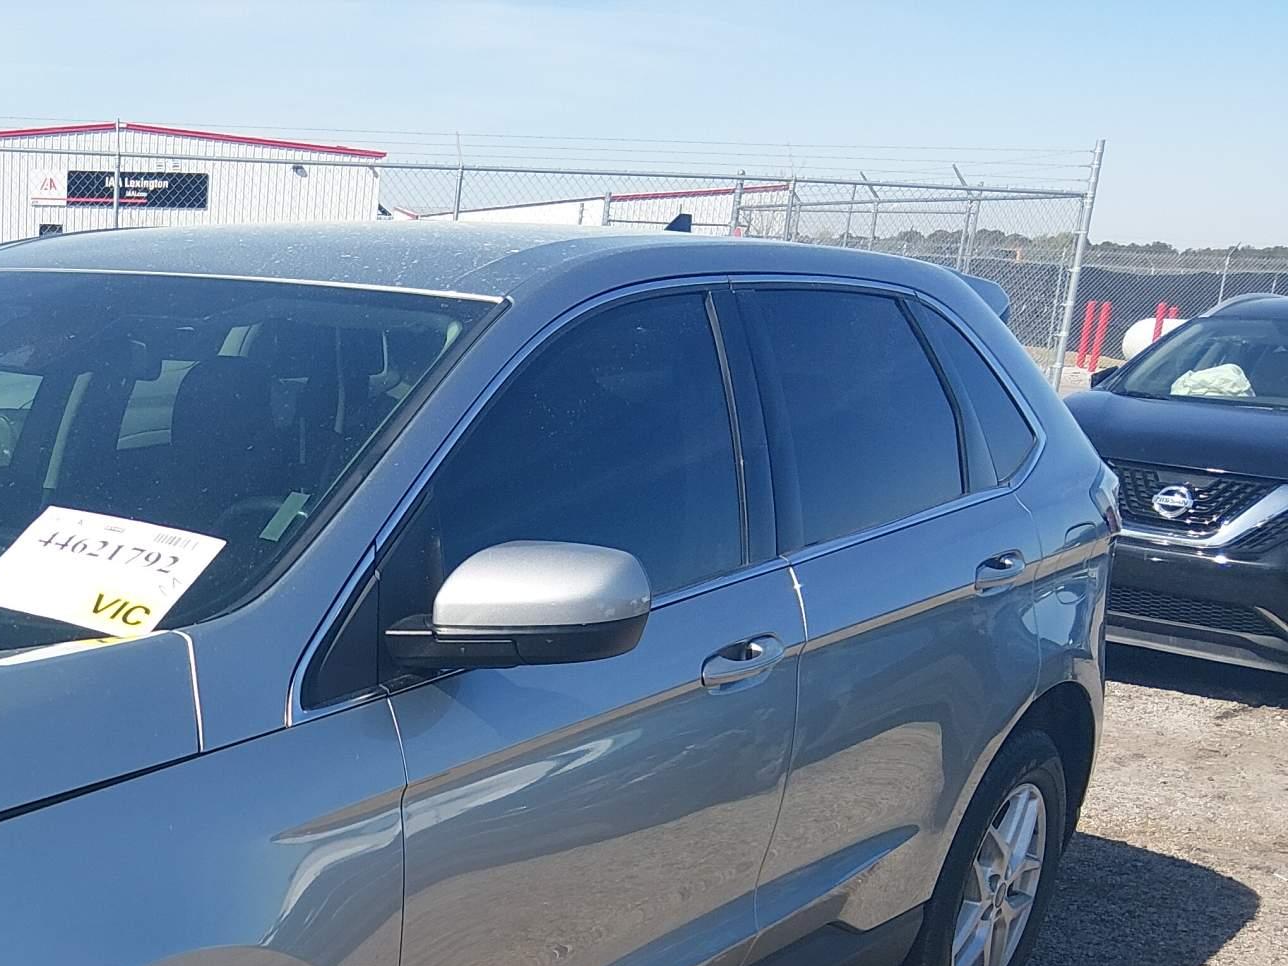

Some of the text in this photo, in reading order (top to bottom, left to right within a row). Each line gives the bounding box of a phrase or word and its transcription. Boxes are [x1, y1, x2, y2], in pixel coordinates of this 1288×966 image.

[125, 176, 169, 191] Lexington
[39, 532, 179, 574] 44621792
[92, 593, 151, 626] VIC
